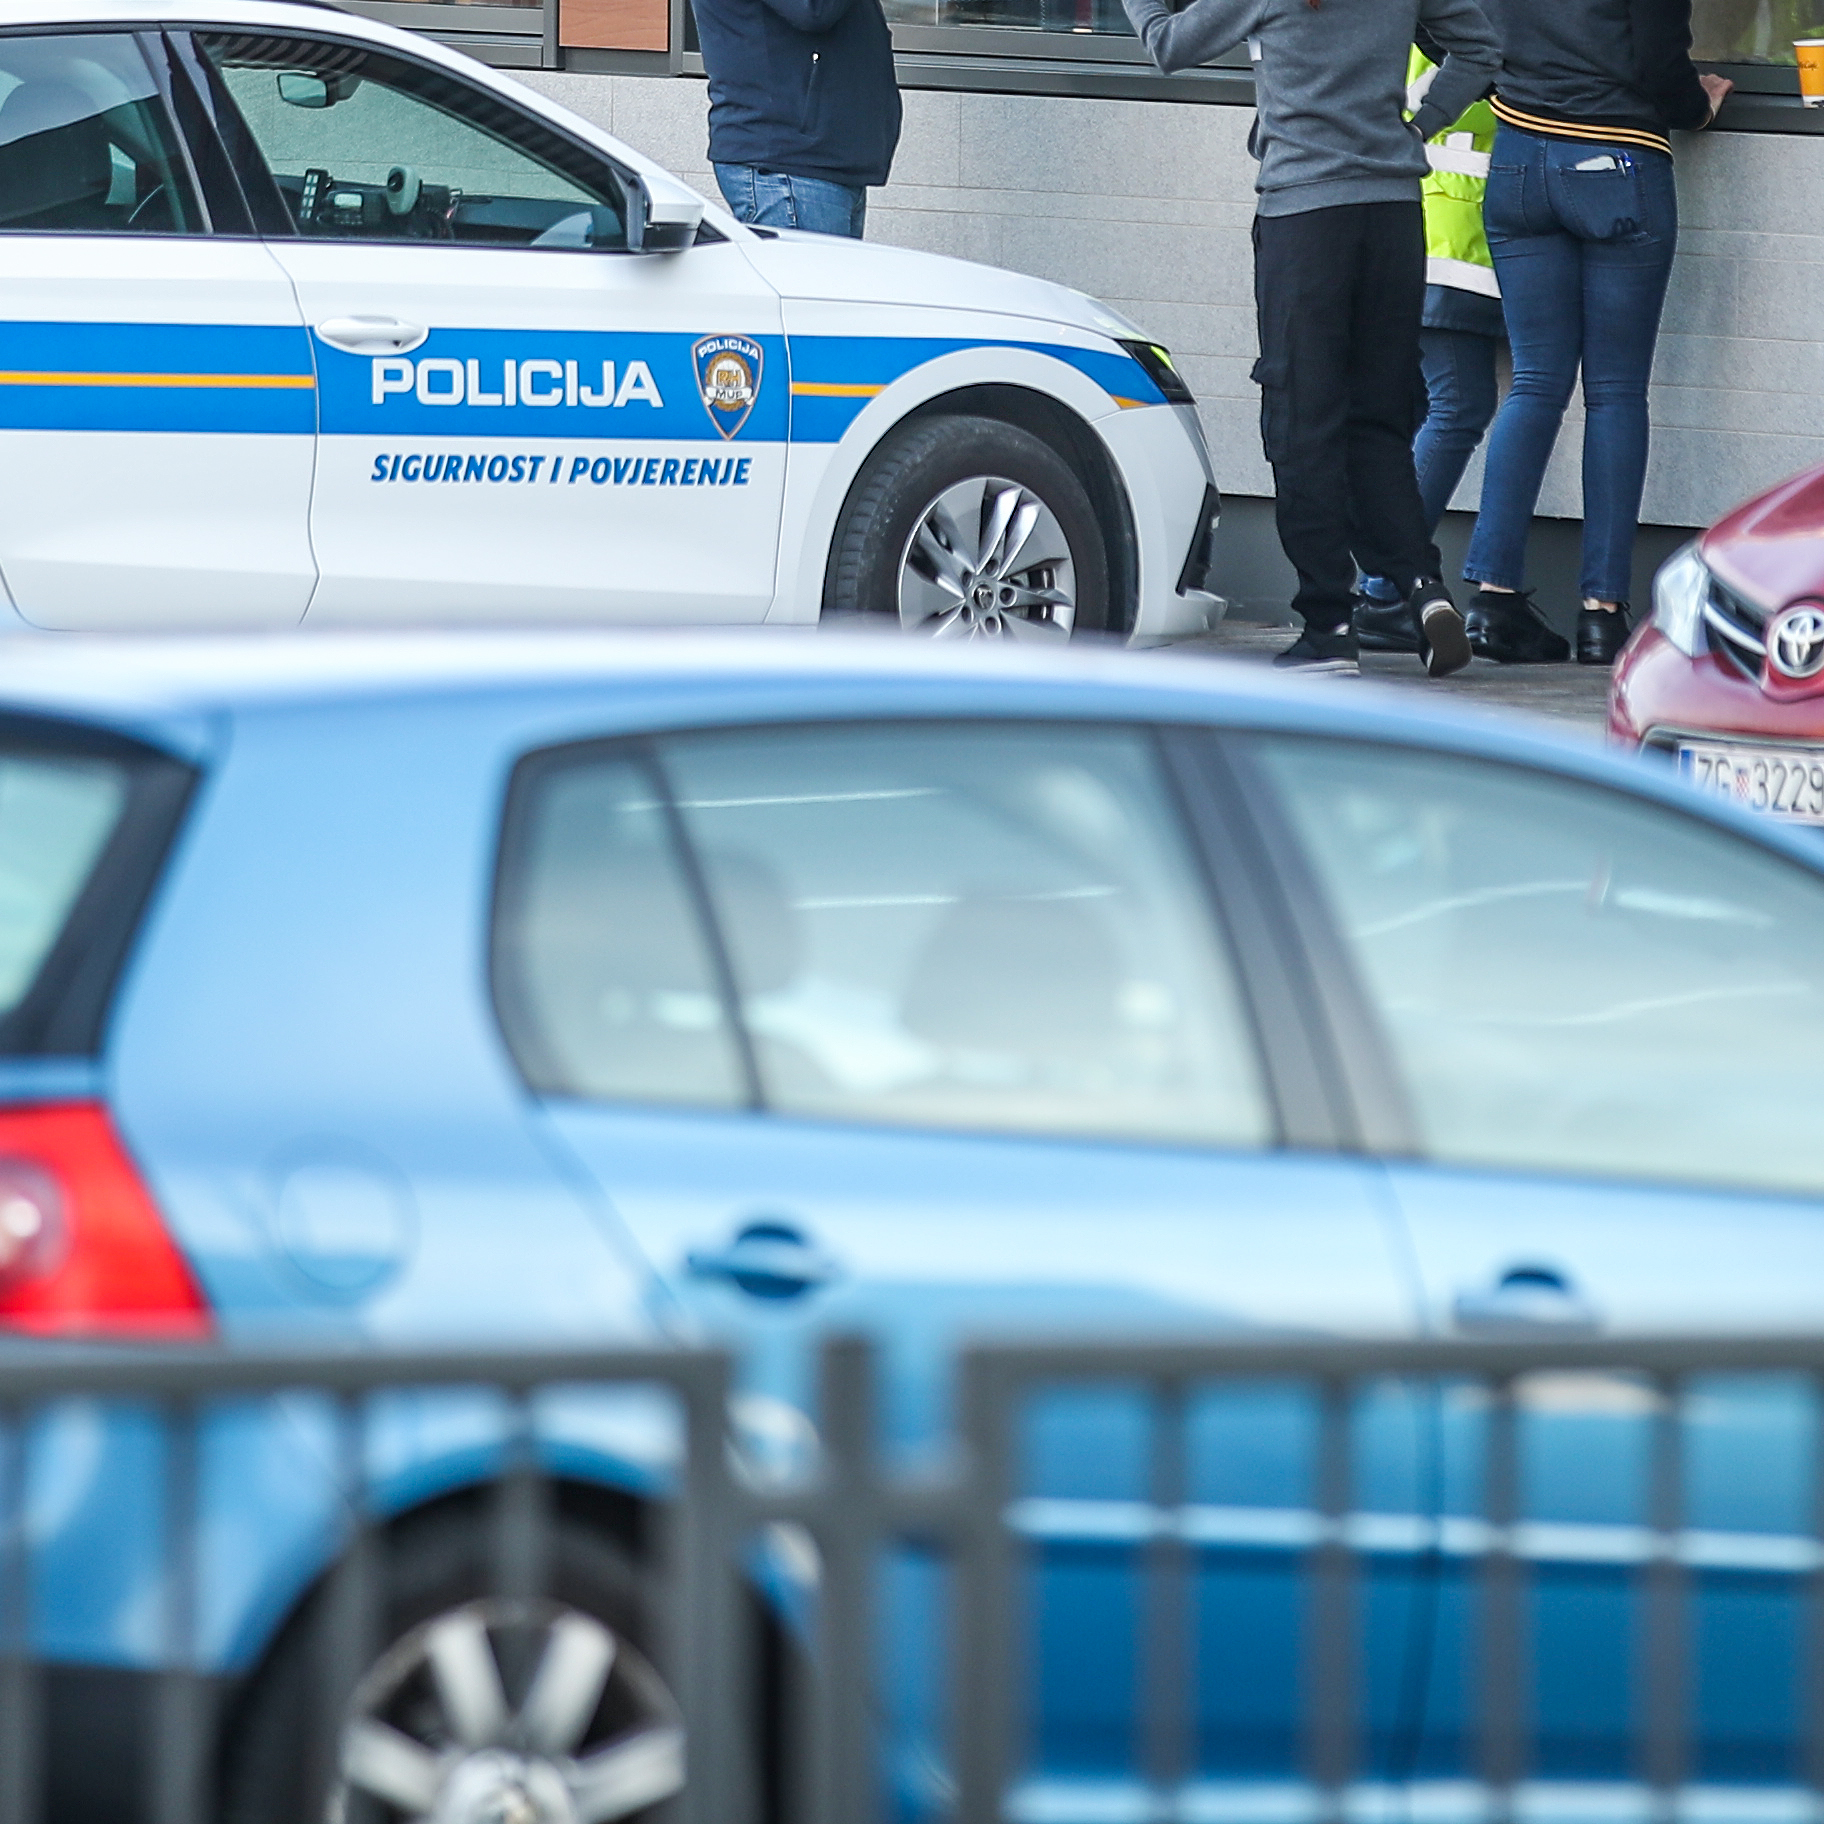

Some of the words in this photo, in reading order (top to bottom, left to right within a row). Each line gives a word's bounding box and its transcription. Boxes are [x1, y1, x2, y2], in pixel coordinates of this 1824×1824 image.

[698, 338, 759, 360] POLICIJA
[372, 358, 664, 408] POLICIJA
[716, 390, 743, 399] MUP
[371, 453, 545, 484] SIGURNOST
[549, 456, 562, 484] I
[569, 456, 754, 488] POVJERENJE
